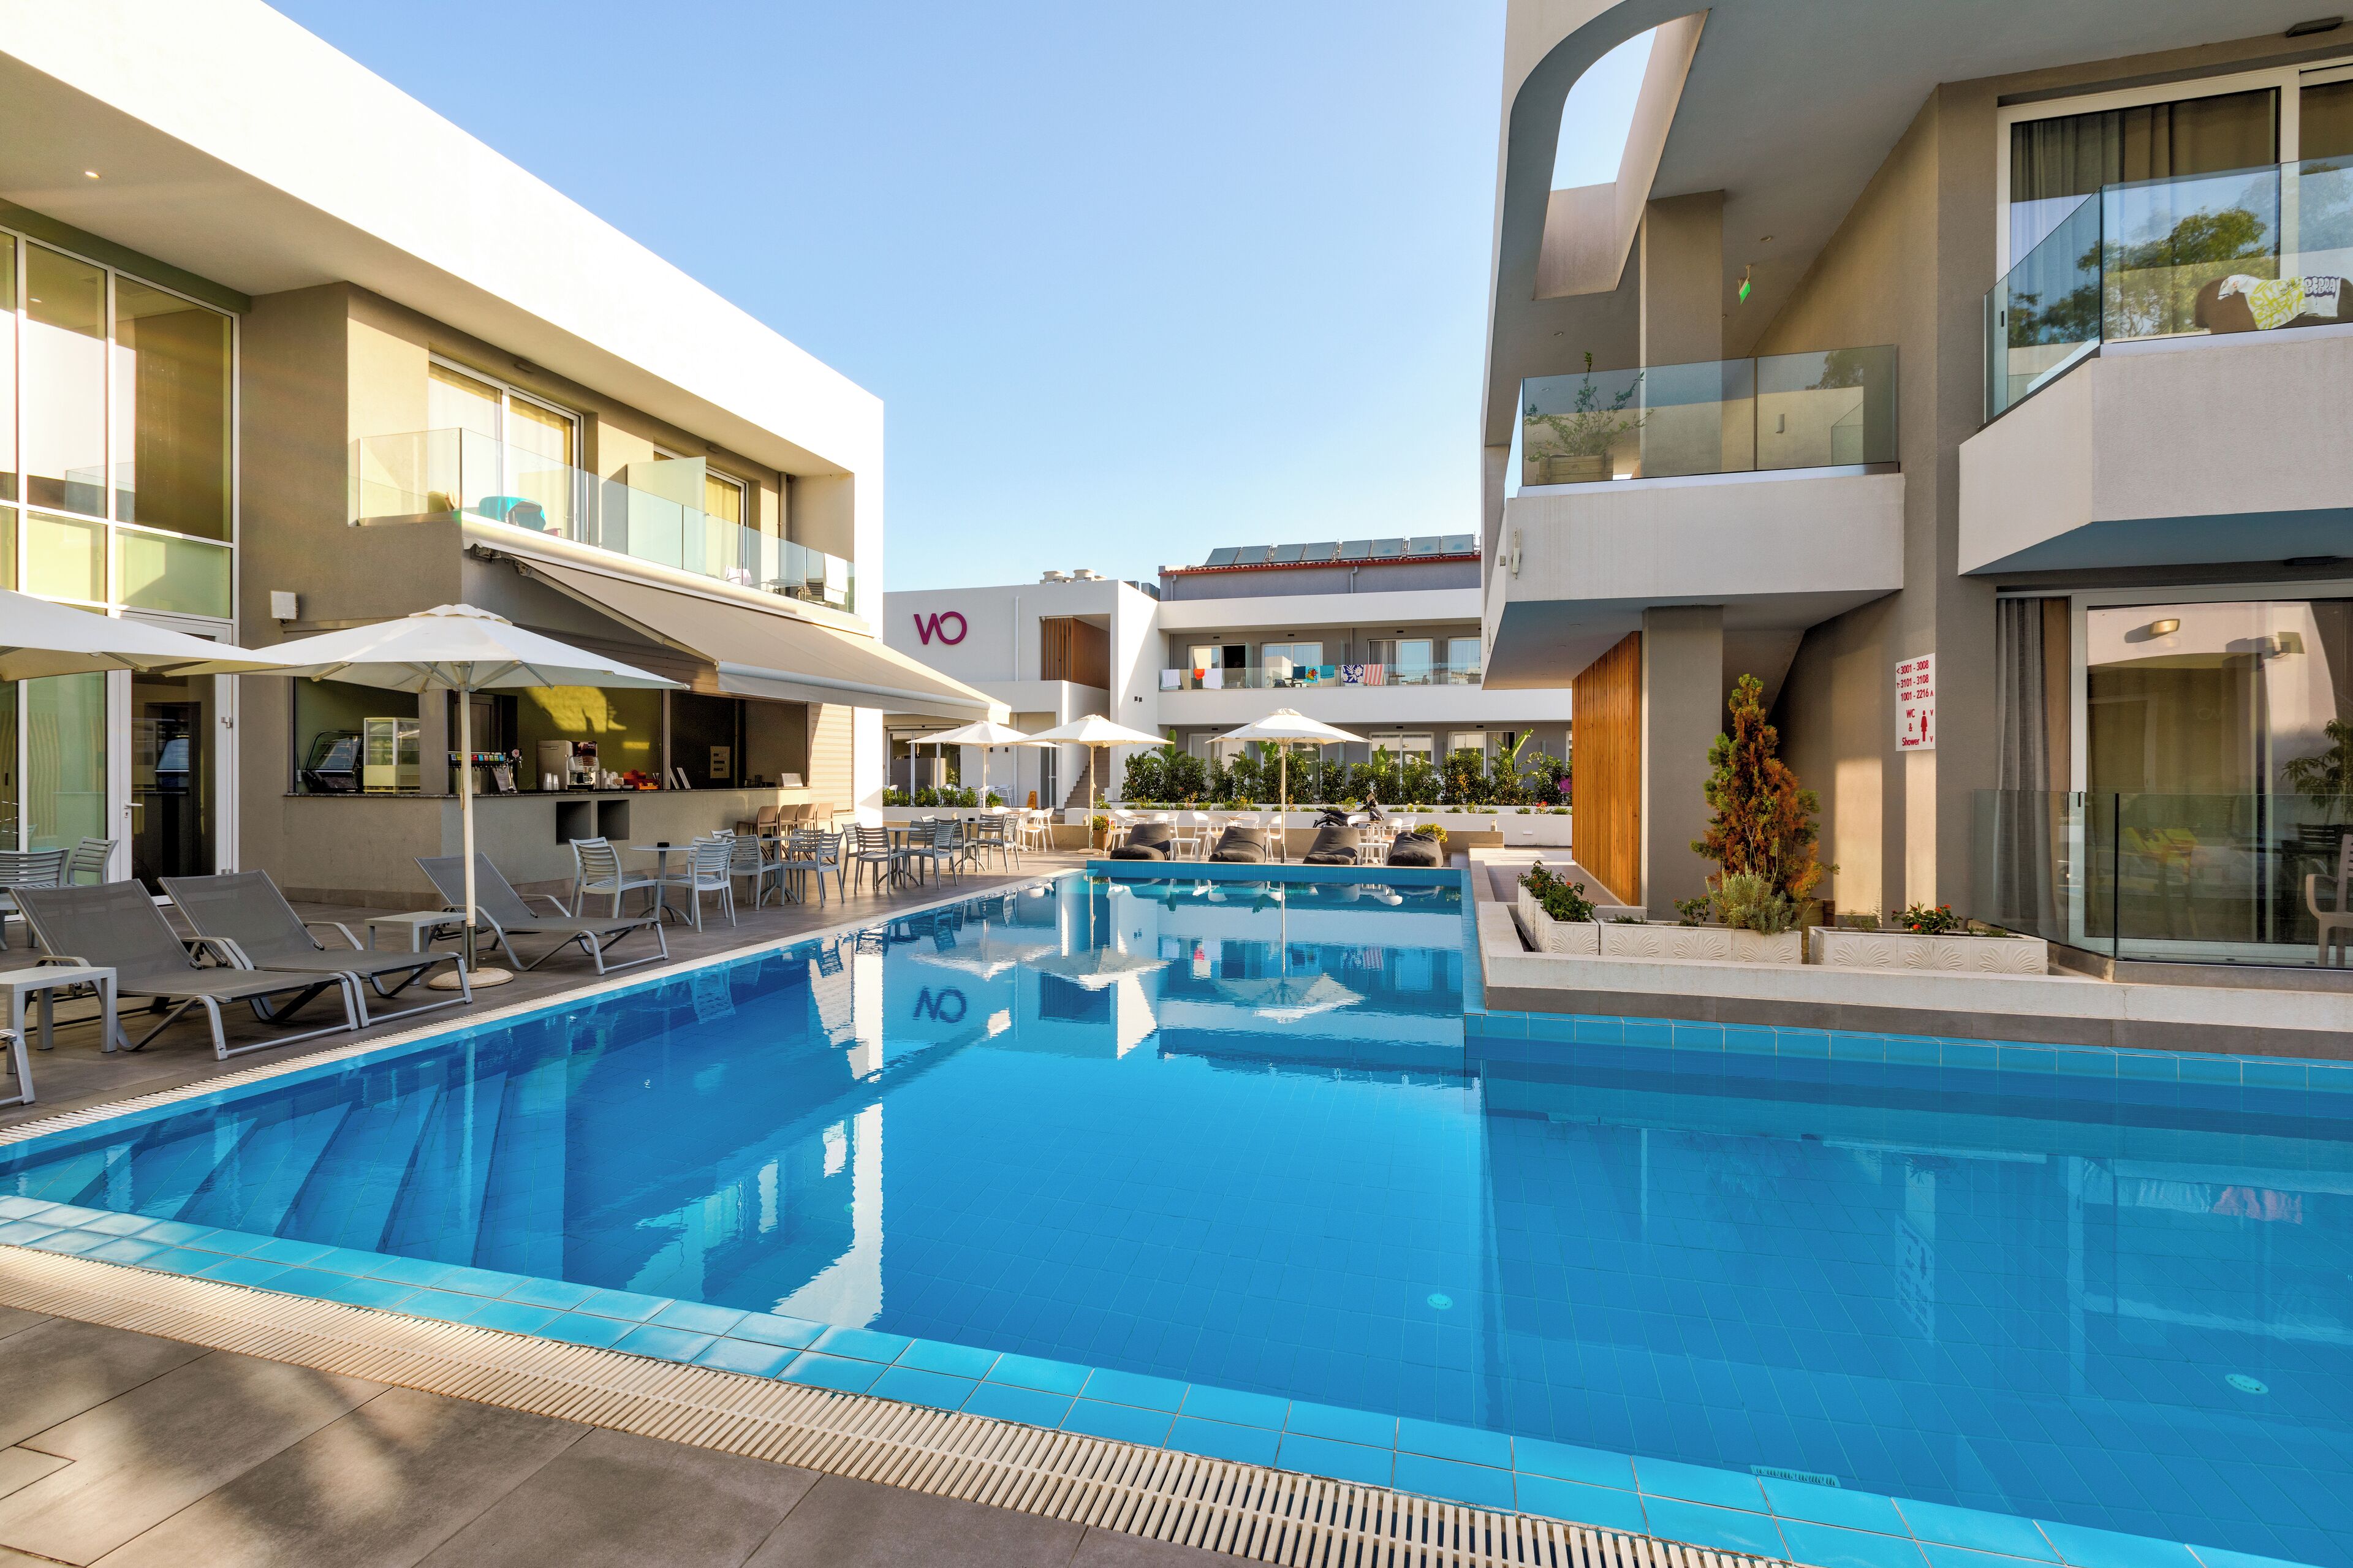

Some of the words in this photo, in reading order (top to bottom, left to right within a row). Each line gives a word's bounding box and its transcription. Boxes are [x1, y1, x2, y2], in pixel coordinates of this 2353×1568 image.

[1901, 664, 1912, 675] 3001
[1916, 659, 1929, 671] 3008
[1901, 677, 1912, 688] 3101
[1916, 674, 1929, 685] 3108
[1901, 691, 1912, 702] 1001
[1916, 688, 1929, 699] 2216
[1906, 708, 1915, 718] WC
[1908, 722, 1913, 732] &
[1902, 737, 1920, 746] Shower
